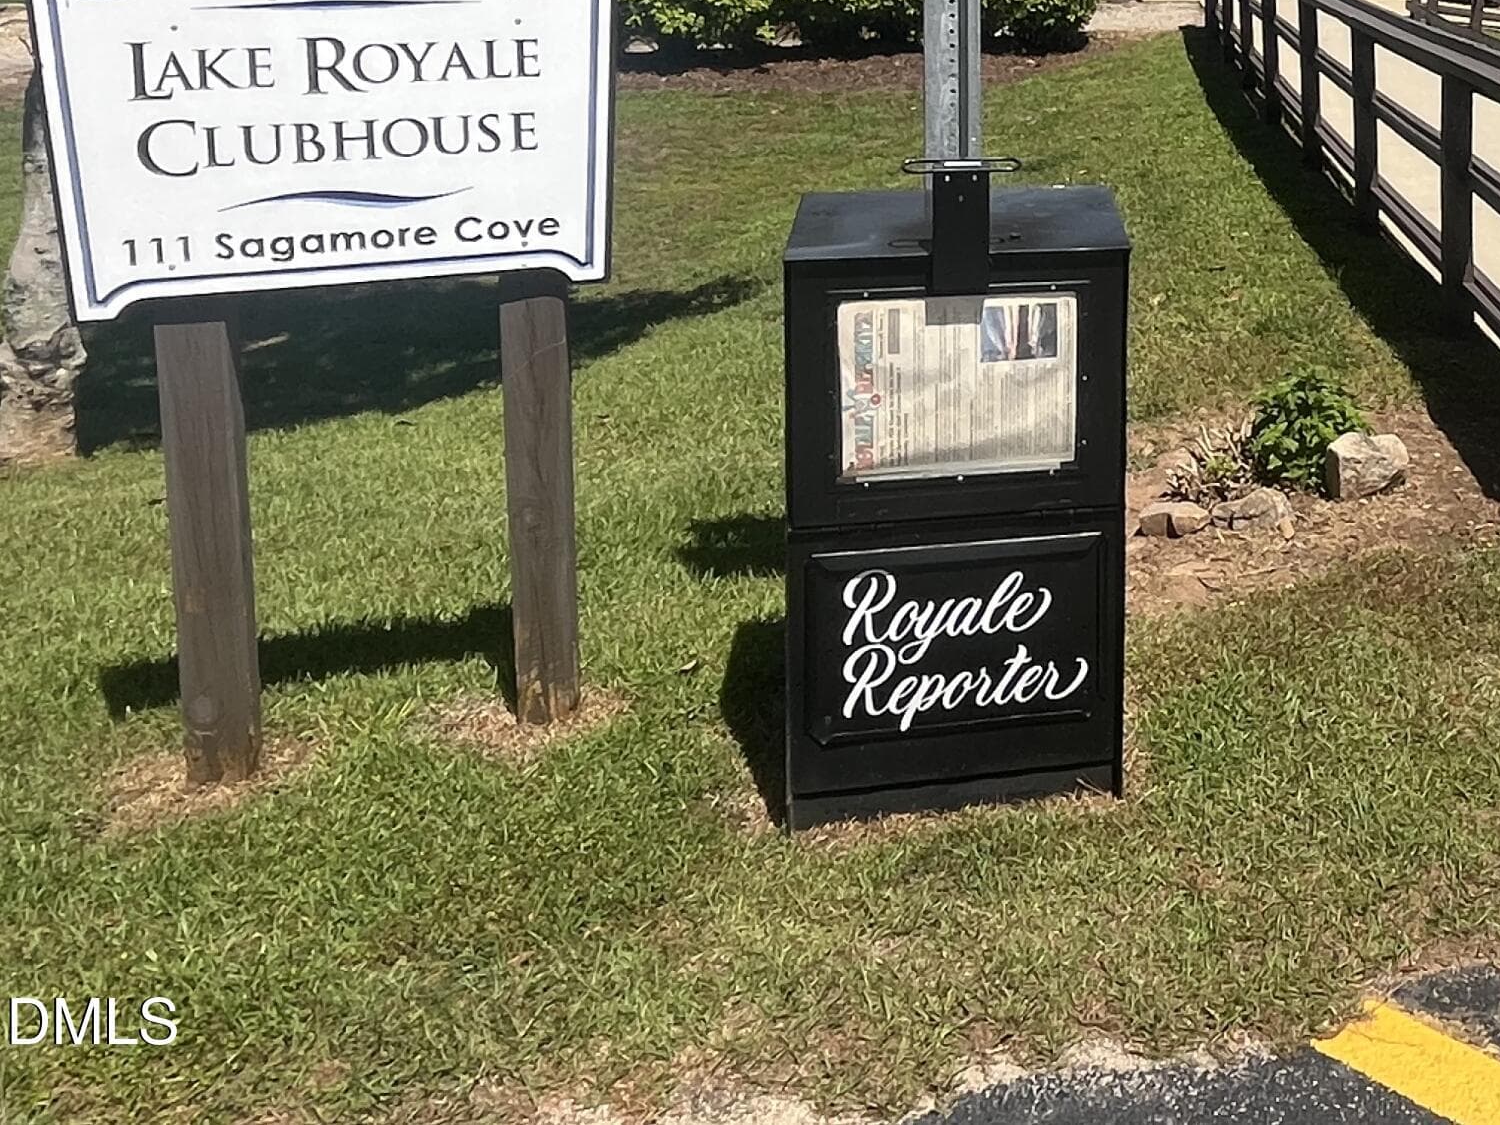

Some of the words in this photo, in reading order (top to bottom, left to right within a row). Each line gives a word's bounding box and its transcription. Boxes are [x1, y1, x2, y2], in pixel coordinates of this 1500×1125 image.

[123, 40, 275, 102] LAKE
[298, 35, 542, 96] ROYALE
[136, 110, 539, 178] CLUBHOUSE
[122, 236, 192, 267] 111
[214, 222, 437, 263] Sagamore
[454, 215, 560, 243] Cove
[842, 569, 1052, 665] Royale
[842, 643, 1089, 732] Reporter
